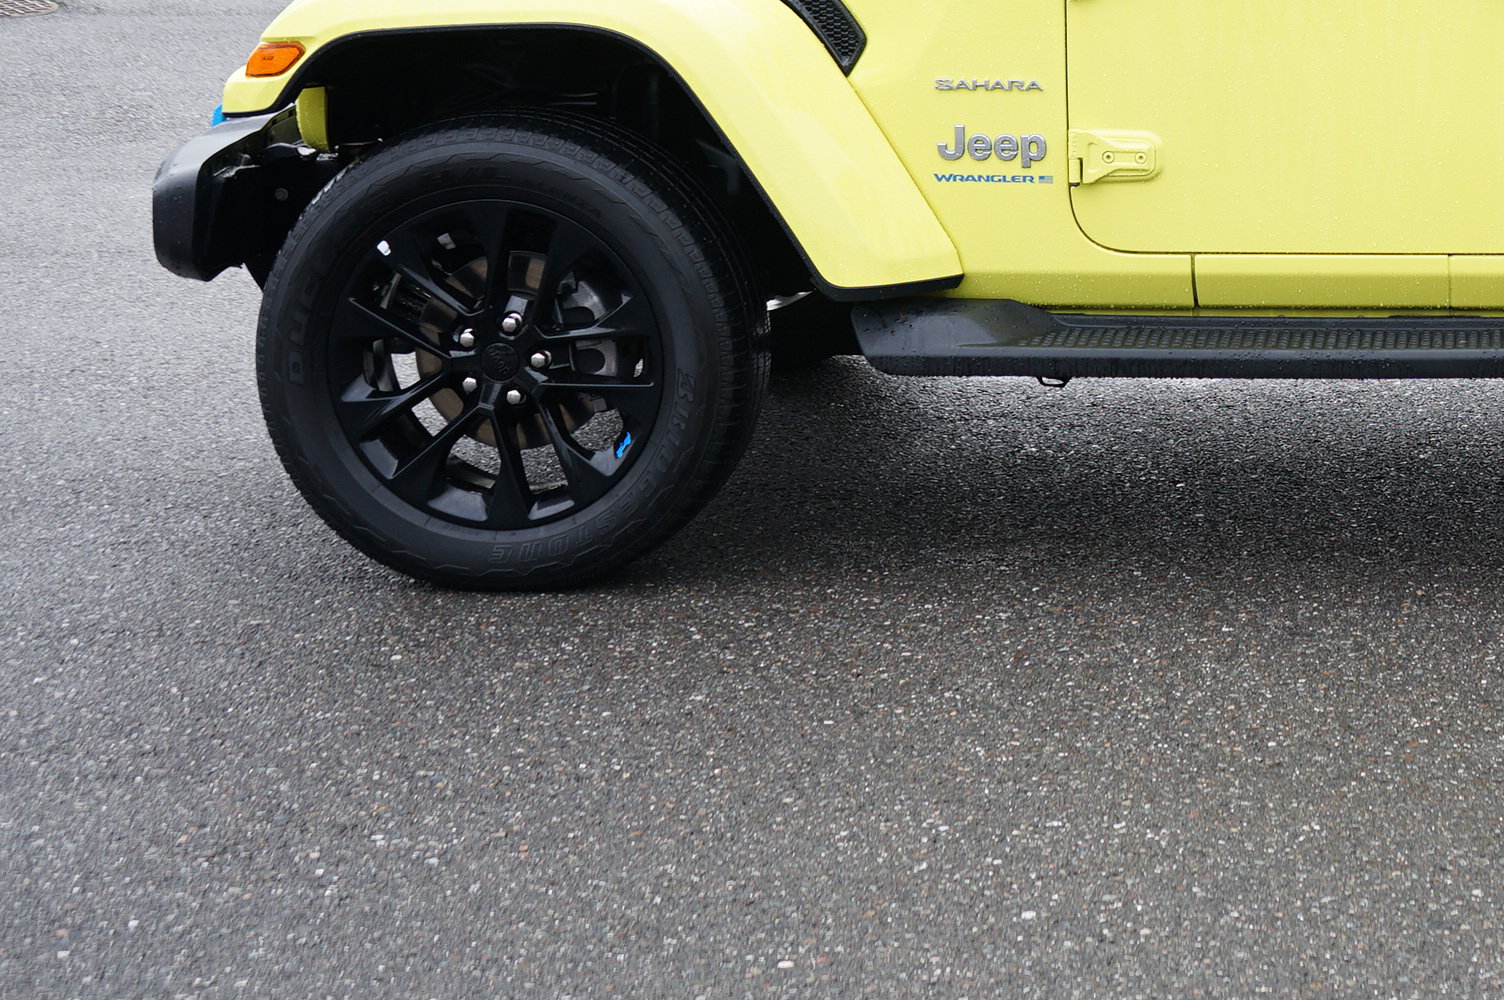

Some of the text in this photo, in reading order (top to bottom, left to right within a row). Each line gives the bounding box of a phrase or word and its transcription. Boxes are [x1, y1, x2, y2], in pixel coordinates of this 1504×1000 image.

[935, 78, 1044, 91] SAHARA
[937, 124, 1048, 169] Jeep
[933, 173, 1035, 184] WRANGLER
[489, 368, 697, 565] BRIDGESTONE
